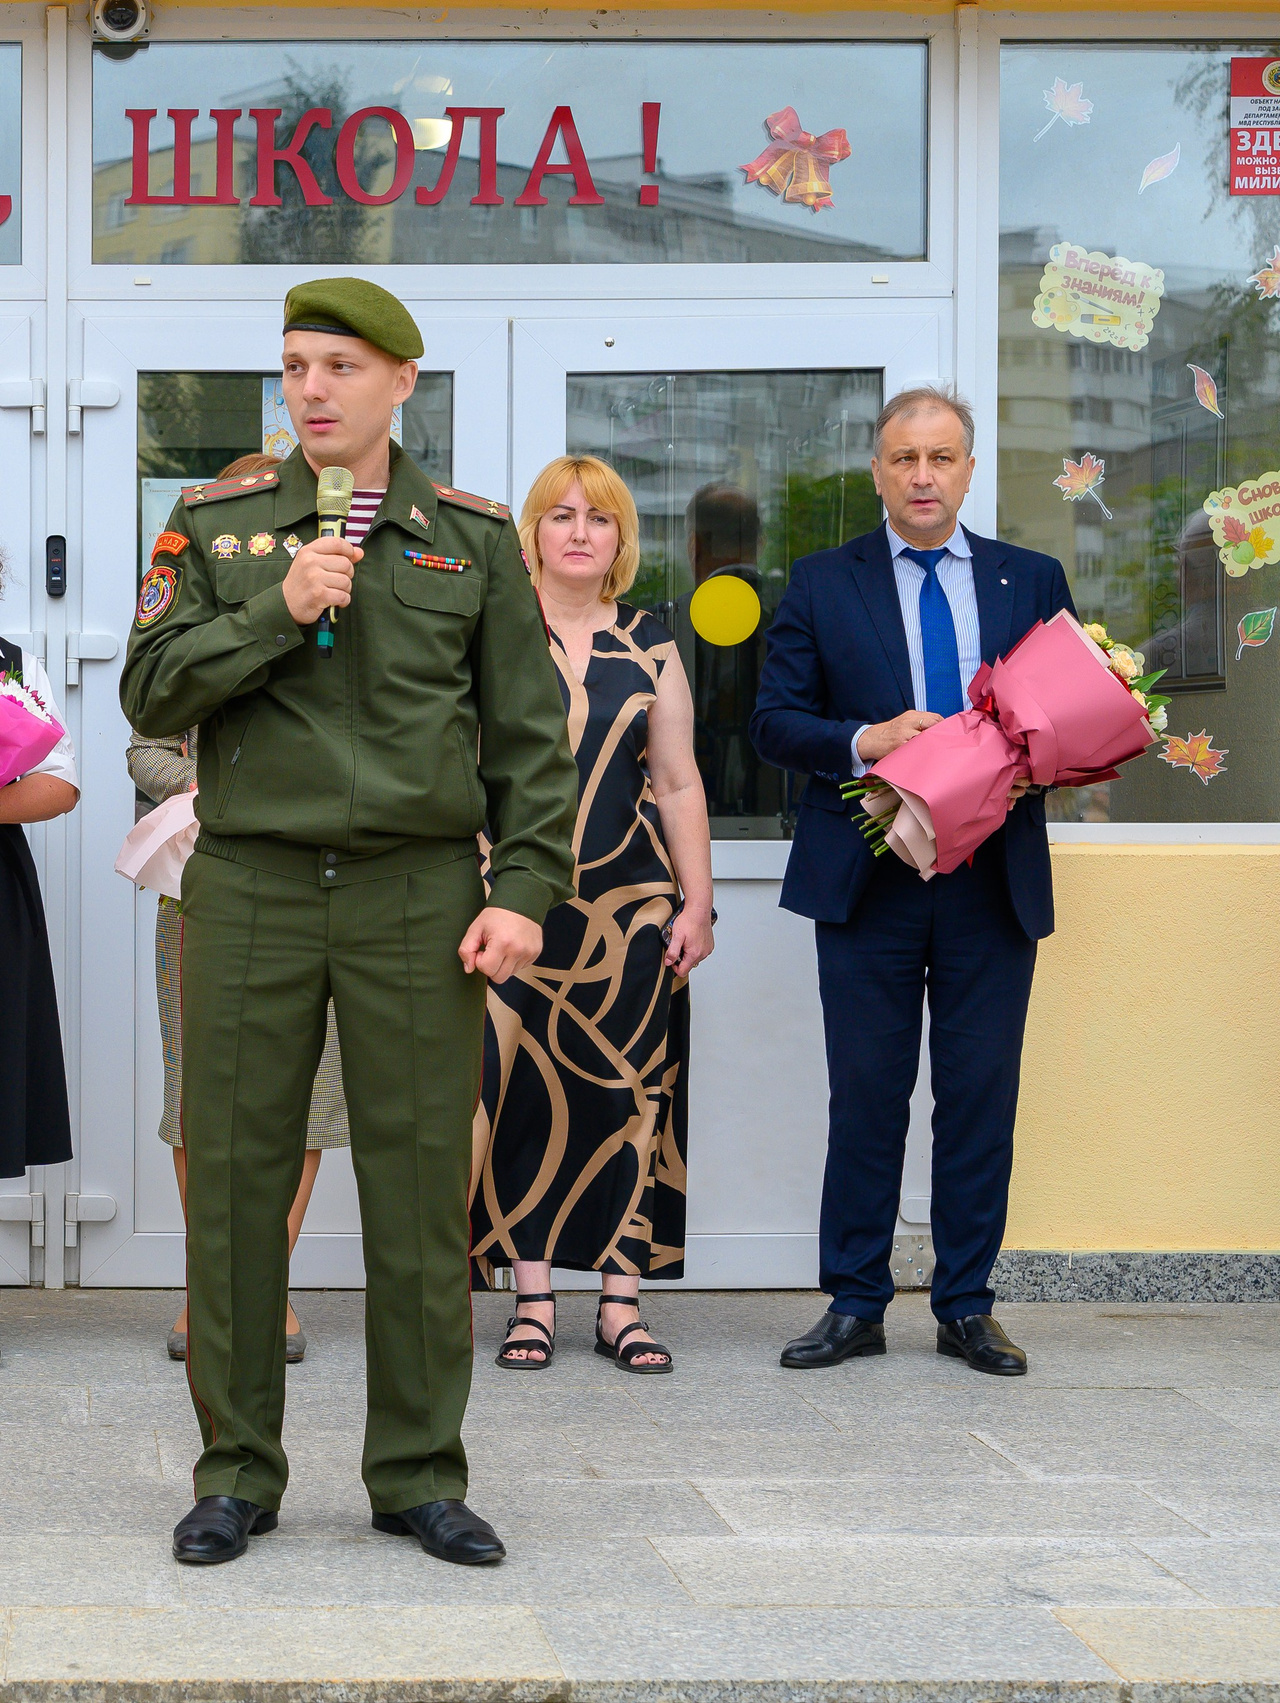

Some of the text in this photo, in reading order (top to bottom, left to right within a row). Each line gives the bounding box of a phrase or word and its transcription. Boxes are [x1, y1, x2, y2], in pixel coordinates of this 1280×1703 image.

[1236, 156, 1278, 165] МОЖНО
[1235, 176, 1280, 189] МИЛИ
[1064, 250, 1152, 289] Вперёд к
[1061, 275, 1146, 309] знаниям!
